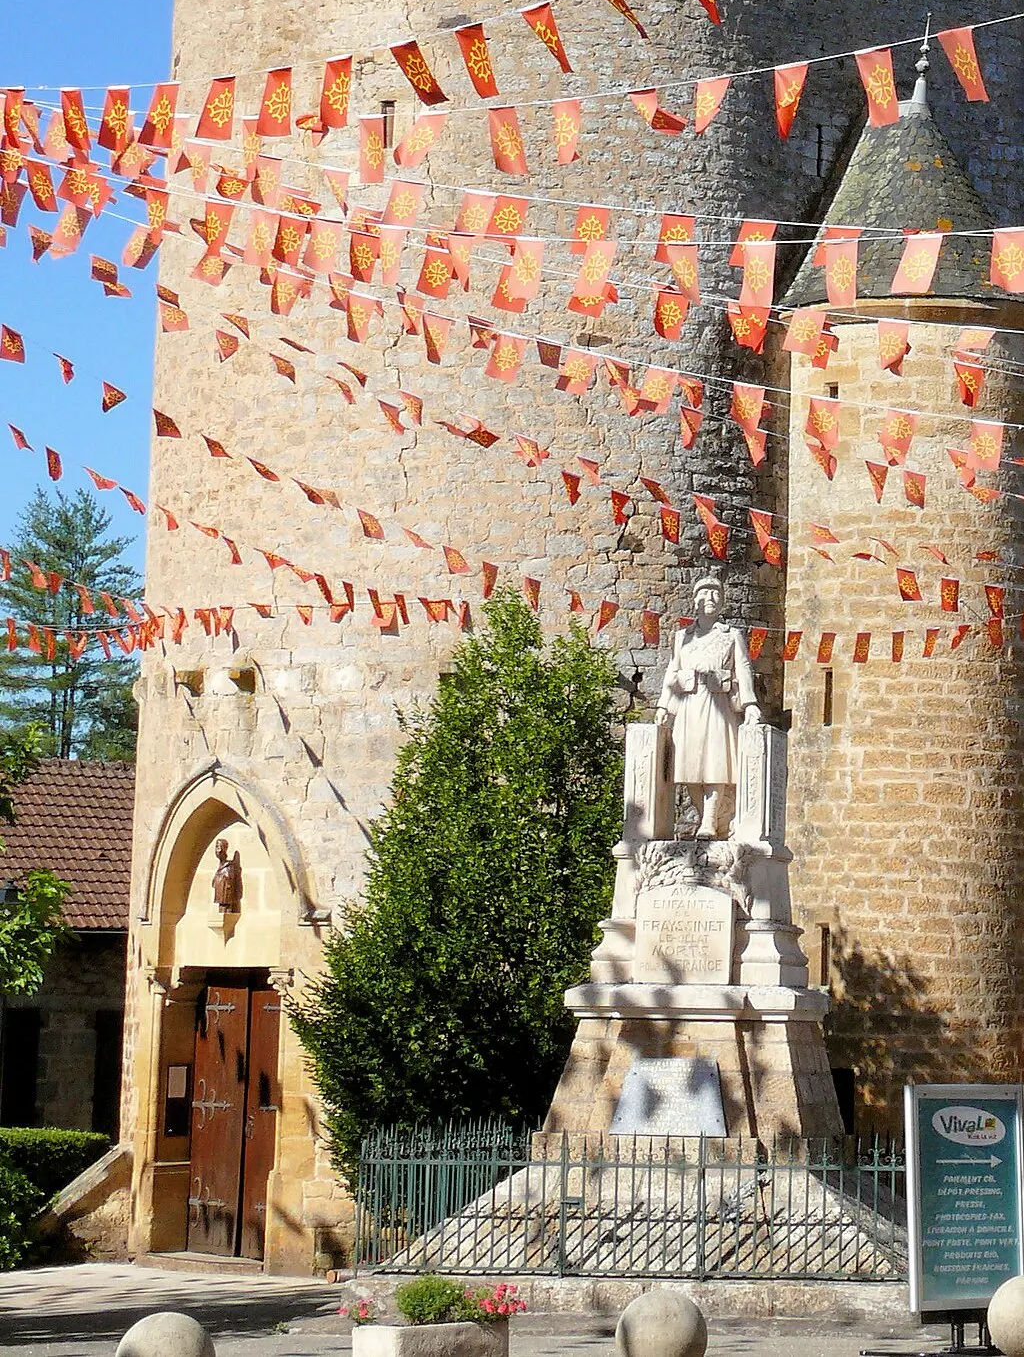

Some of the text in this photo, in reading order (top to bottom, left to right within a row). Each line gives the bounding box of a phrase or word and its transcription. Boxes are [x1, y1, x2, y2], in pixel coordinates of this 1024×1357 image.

[653, 899, 715, 909] ENFANTS
[642, 920, 725, 931] FRAYSSINET
[652, 945, 709, 957] MORTS
[676, 959, 723, 971] FRANCE
